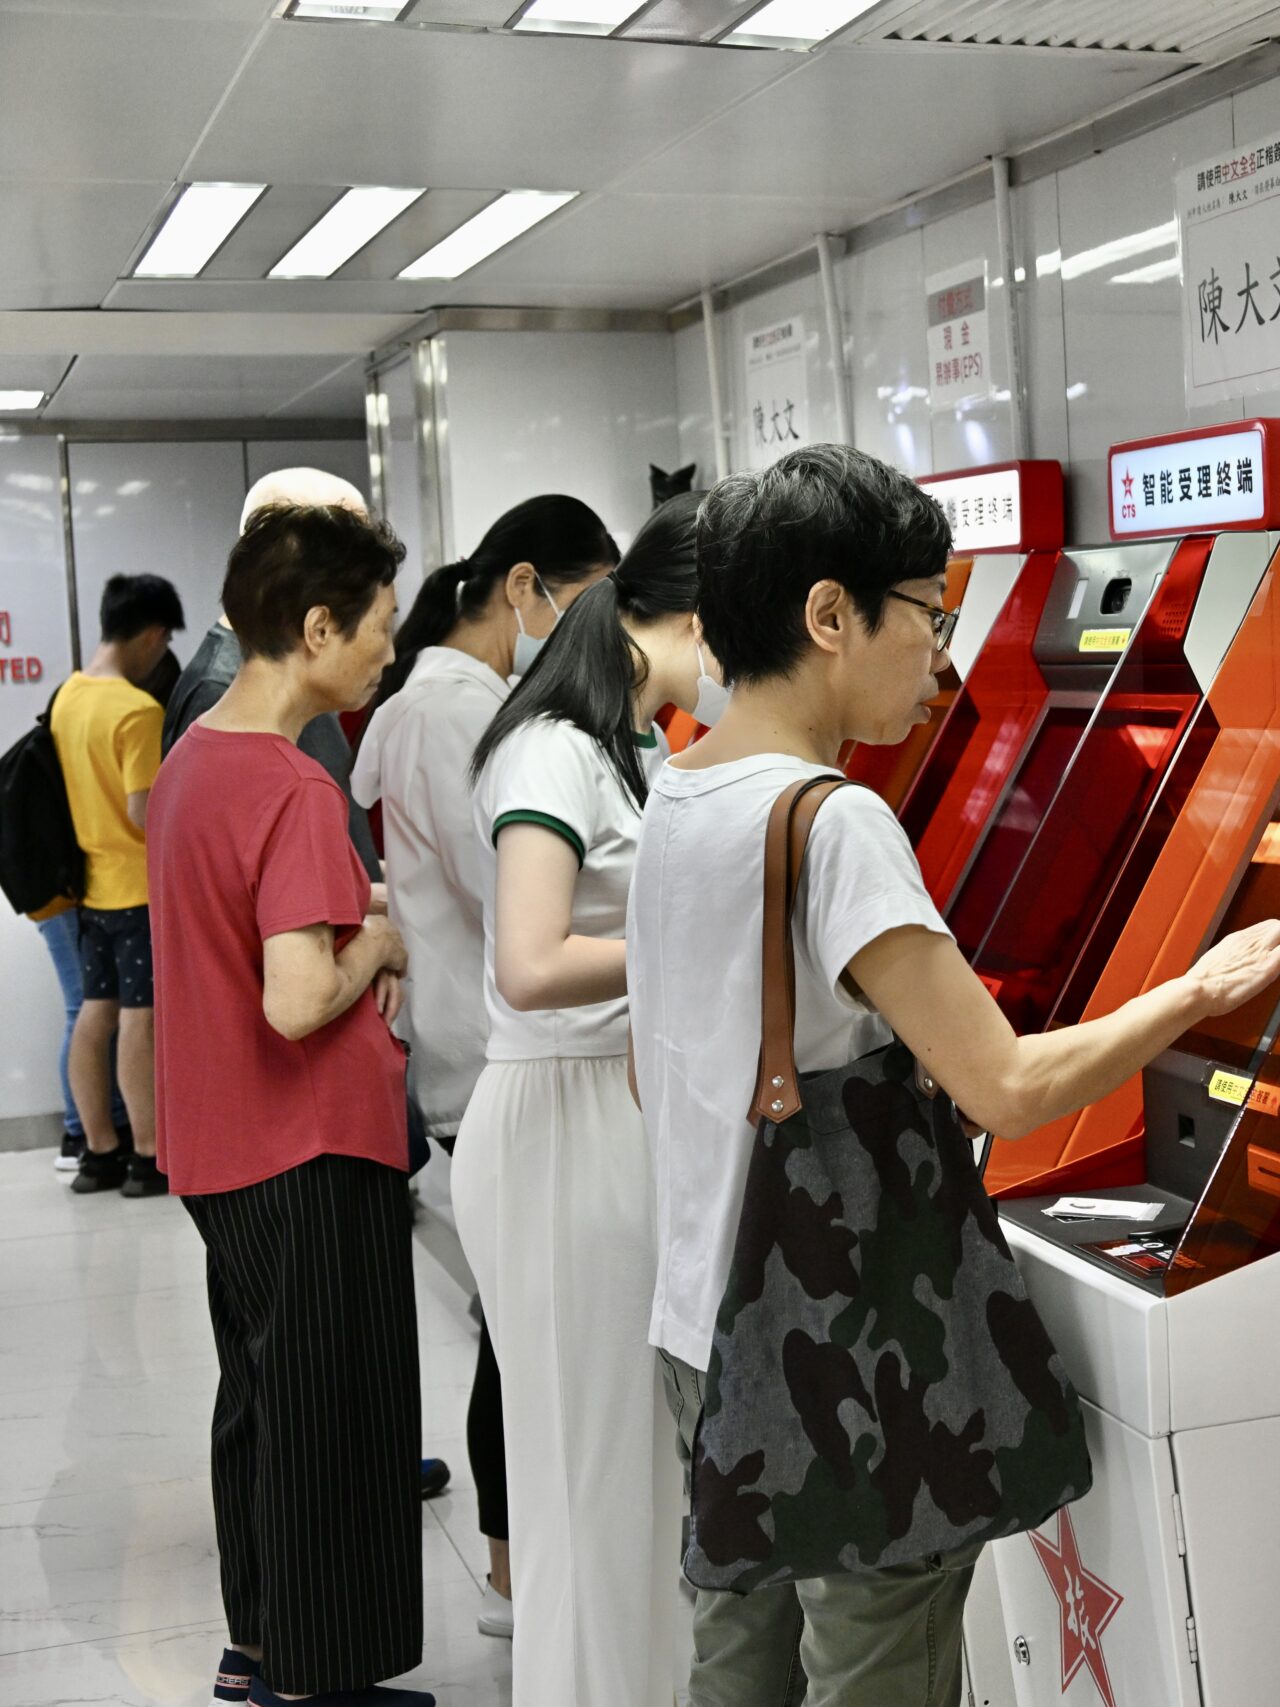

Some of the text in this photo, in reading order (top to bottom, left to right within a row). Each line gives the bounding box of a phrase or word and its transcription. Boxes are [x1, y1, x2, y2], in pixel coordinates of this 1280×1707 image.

[1142, 457, 1254, 507] 智能受理終端
[1121, 504, 1136, 519] CTS
